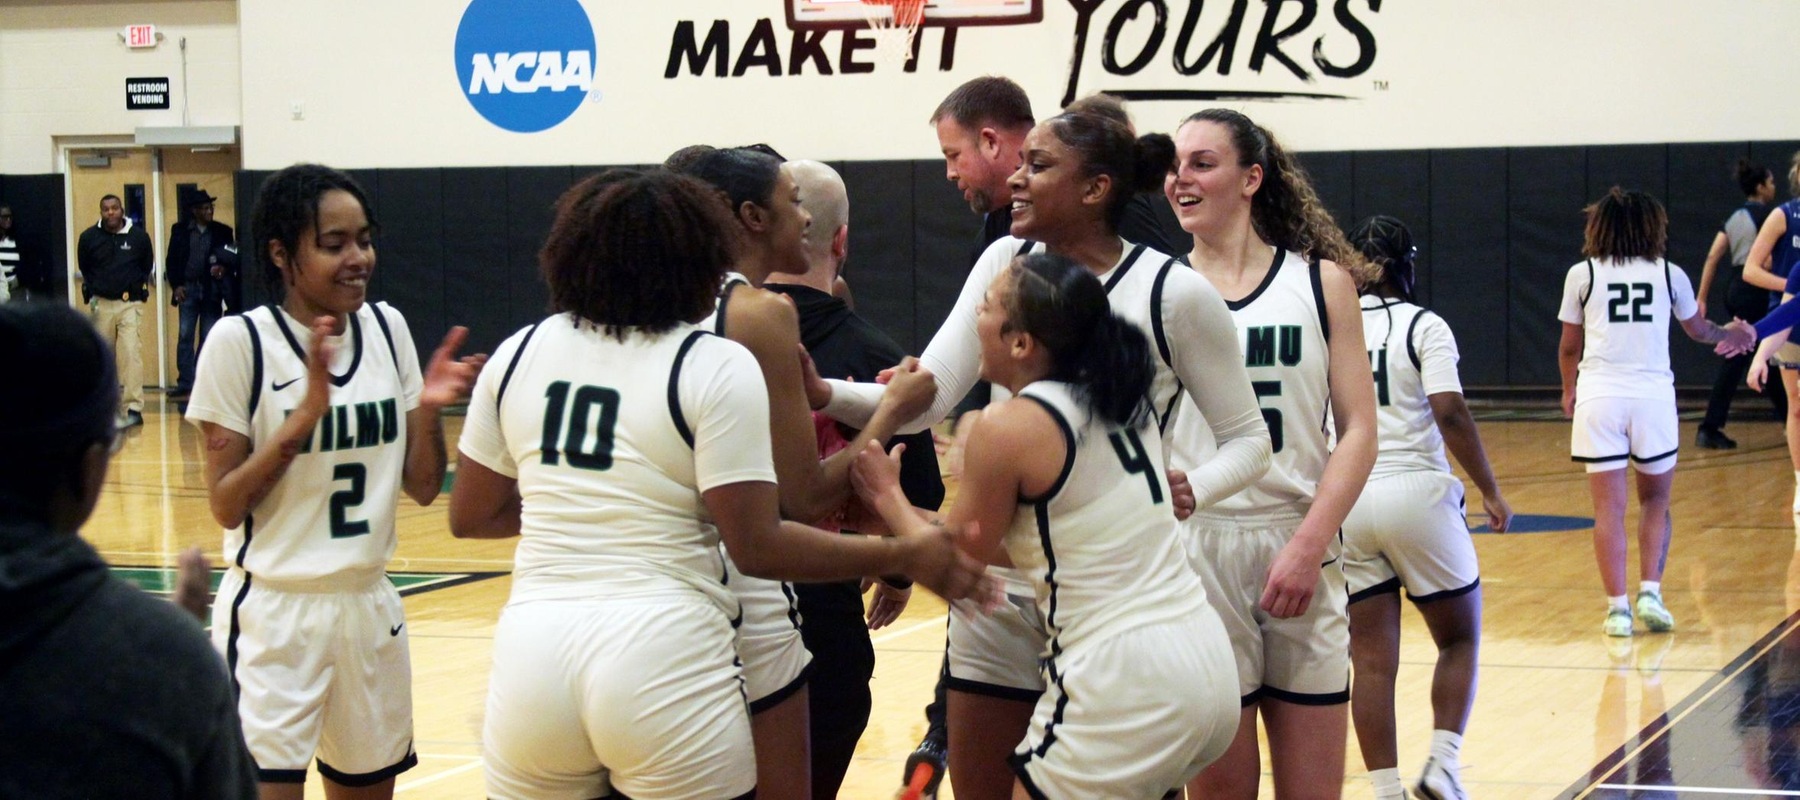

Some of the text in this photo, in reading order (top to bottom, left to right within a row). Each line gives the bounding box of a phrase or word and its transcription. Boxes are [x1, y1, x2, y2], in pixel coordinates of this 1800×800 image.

[130, 26, 151, 46] EXIT
[664, 18, 877, 78] MAKE
[1061, 0, 1382, 109] YOURS
[127, 83, 168, 94] RESTROOM
[469, 50, 592, 94] NCAA
[132, 94, 164, 105] VENDING
[1607, 282, 1653, 323] 22
[540, 380, 621, 471] 10
[1108, 426, 1164, 506] 4
[328, 462, 371, 540] 2
